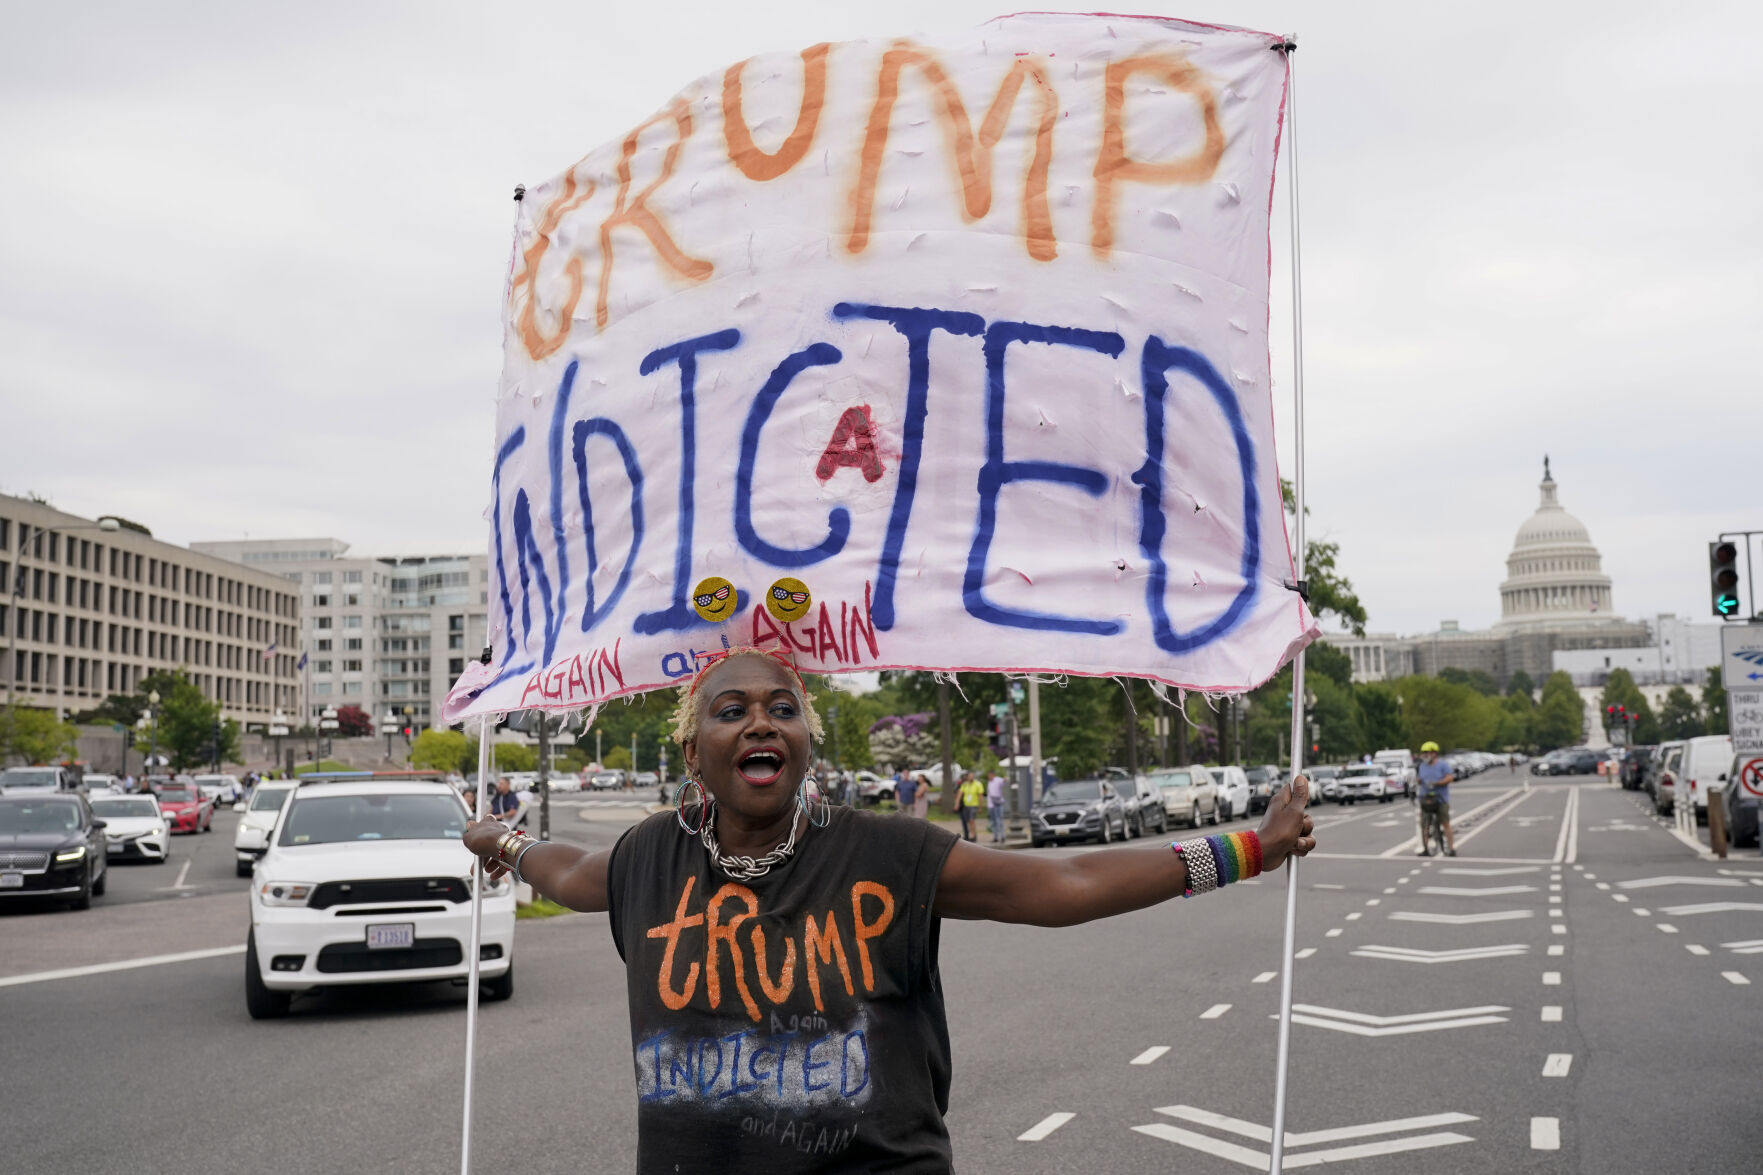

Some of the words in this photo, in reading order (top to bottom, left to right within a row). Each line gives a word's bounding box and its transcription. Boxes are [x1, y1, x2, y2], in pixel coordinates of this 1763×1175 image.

[814, 403, 889, 485] A
[466, 301, 1261, 697] INDICTED
[520, 637, 628, 707] AGAIN
[662, 633, 730, 678] an
[752, 580, 880, 665] AGAIN
[770, 1009, 828, 1034] Again
[639, 1027, 870, 1100] INDICTED
[741, 1110, 779, 1137] and
[780, 1120, 858, 1154] AGAIN
